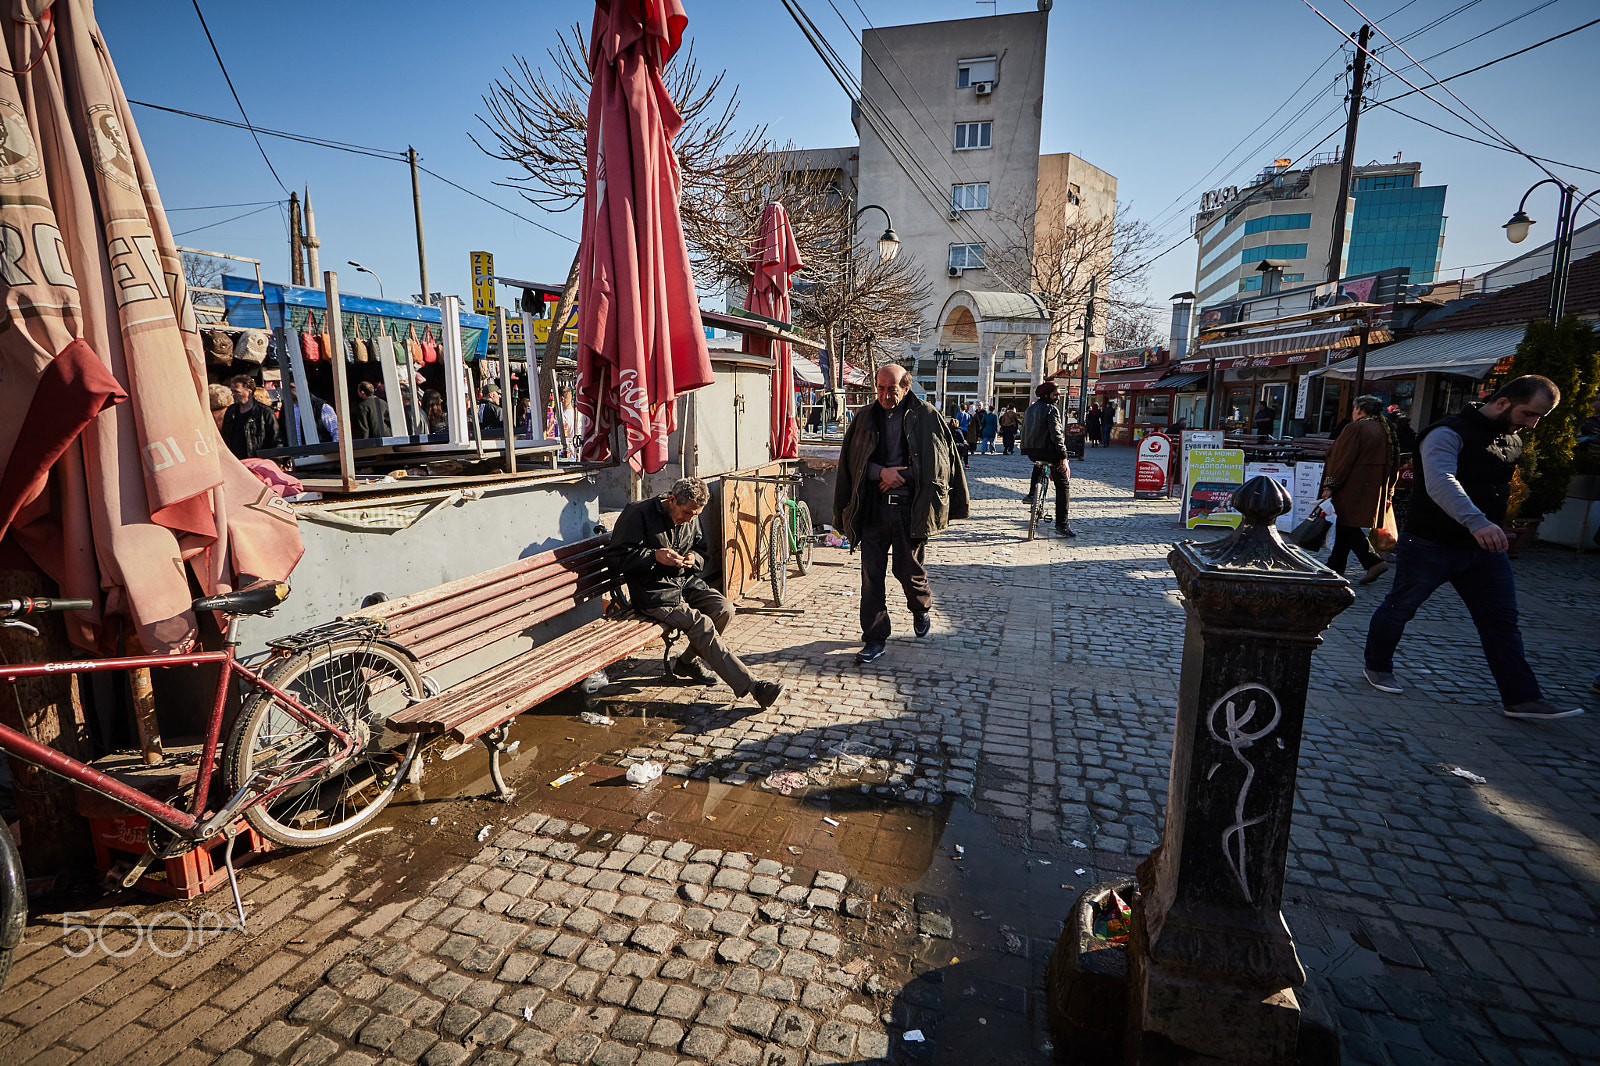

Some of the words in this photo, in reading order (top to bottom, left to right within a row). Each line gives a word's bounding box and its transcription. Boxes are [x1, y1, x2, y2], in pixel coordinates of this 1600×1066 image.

[1199, 185, 1238, 212] ARKA
[486, 254, 494, 310] ZEGIN
[44, 661, 96, 672] CRESTA
